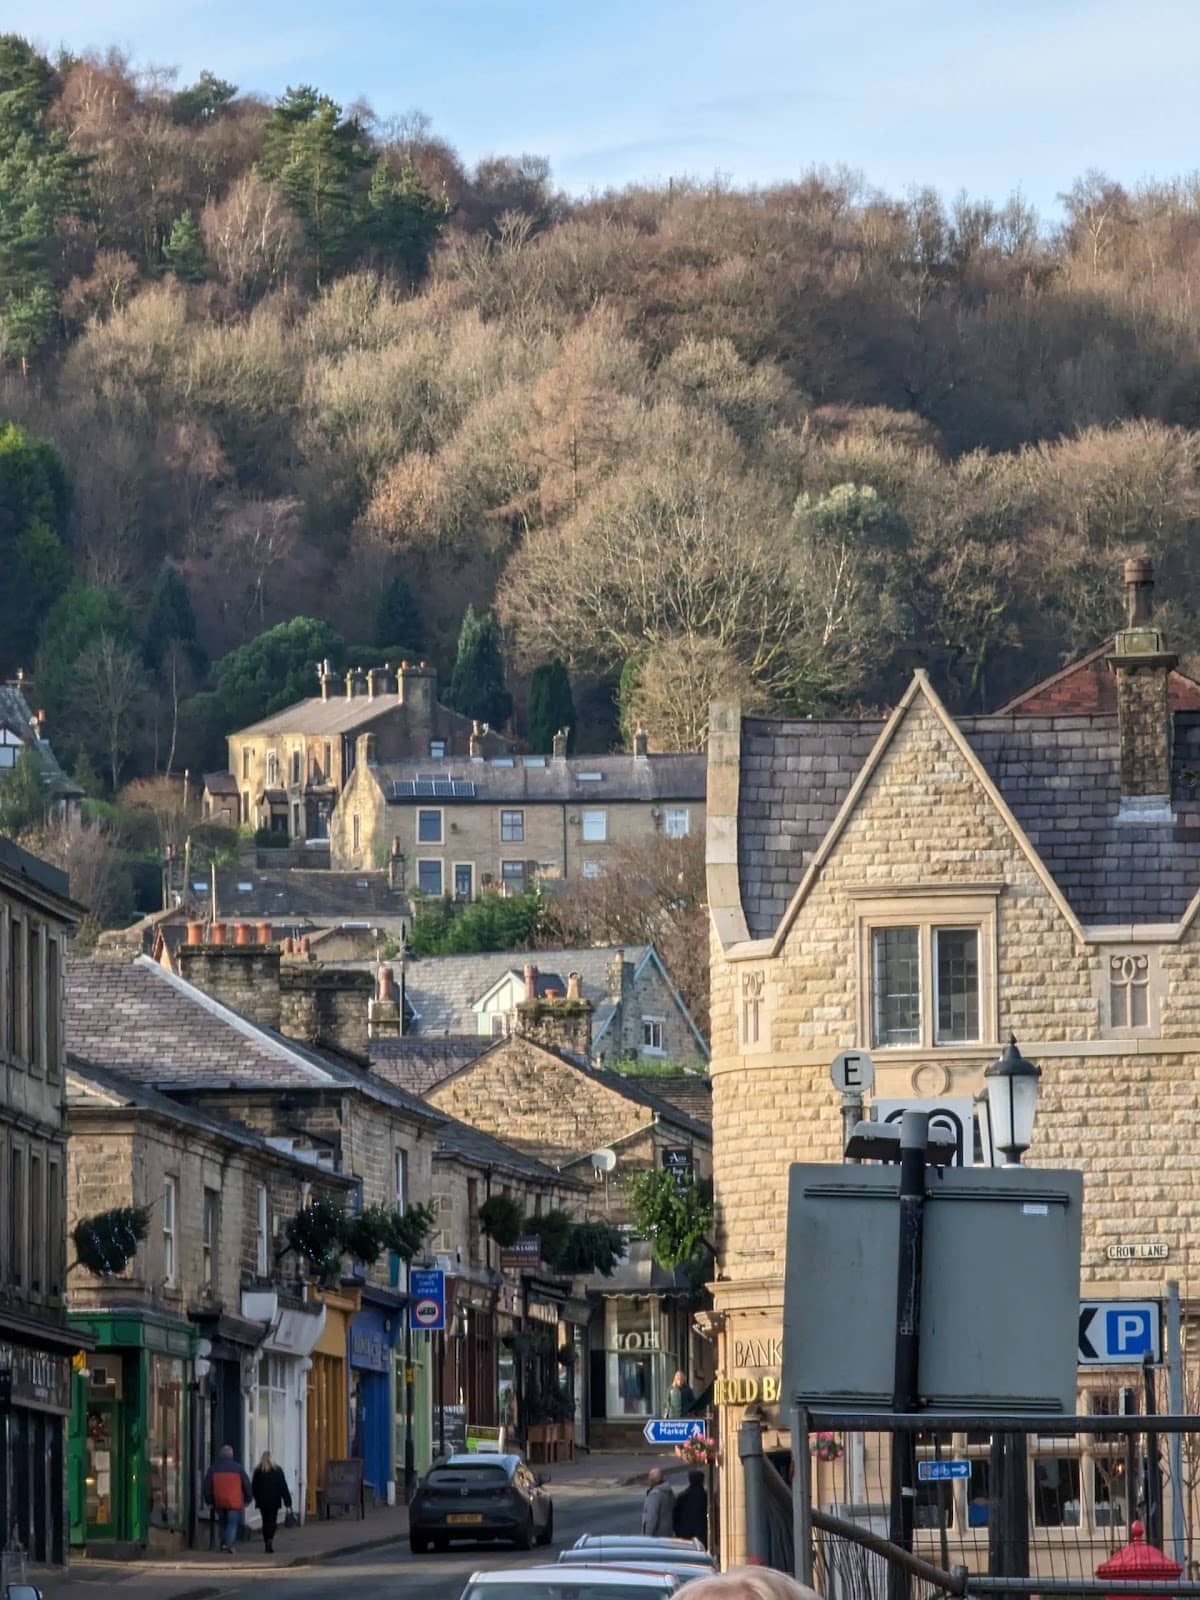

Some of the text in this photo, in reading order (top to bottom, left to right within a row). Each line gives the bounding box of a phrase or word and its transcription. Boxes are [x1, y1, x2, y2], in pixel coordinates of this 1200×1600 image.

[844, 1056, 862, 1086] E
[1109, 1245, 1165, 1257] CROW LANE
[1117, 1315, 1144, 1351] P
[735, 1338, 783, 1368] BANK
[728, 1377, 758, 1404] OLD
[660, 1427, 687, 1436] Market
